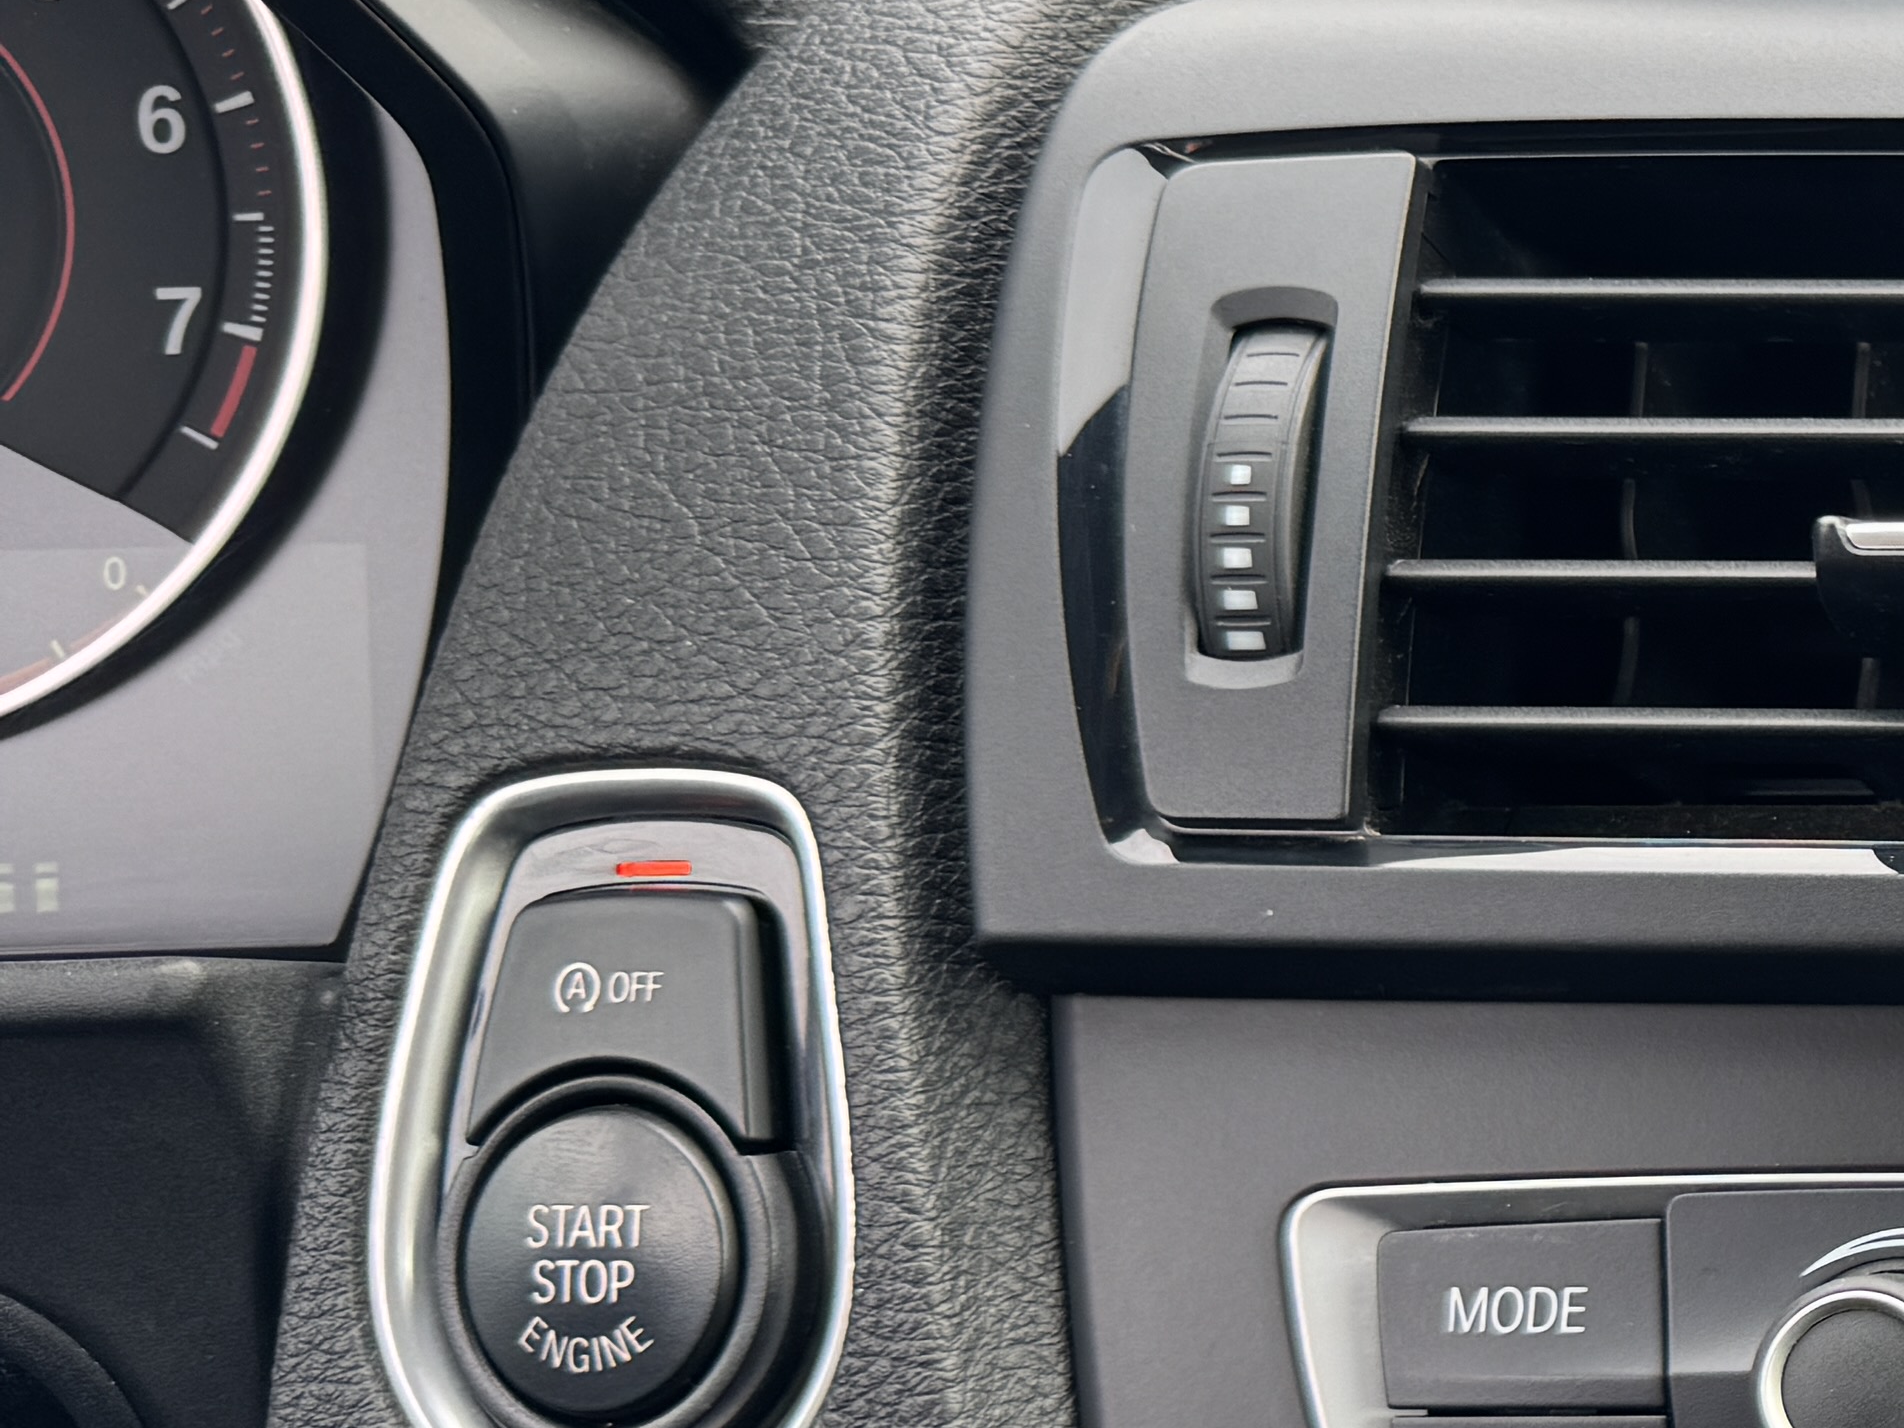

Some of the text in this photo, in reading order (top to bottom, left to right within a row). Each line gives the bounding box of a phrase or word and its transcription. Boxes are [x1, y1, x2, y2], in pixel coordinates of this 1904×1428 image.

[137, 84, 187, 155] 6
[154, 284, 203, 356] 7
[103, 556, 127, 591] 0
[607, 970, 665, 1003] OFF
[526, 1203, 650, 1251] START
[530, 1258, 636, 1305] STOP
[1447, 1285, 1588, 1336] MODE
[516, 1316, 655, 1374] ENGINE
